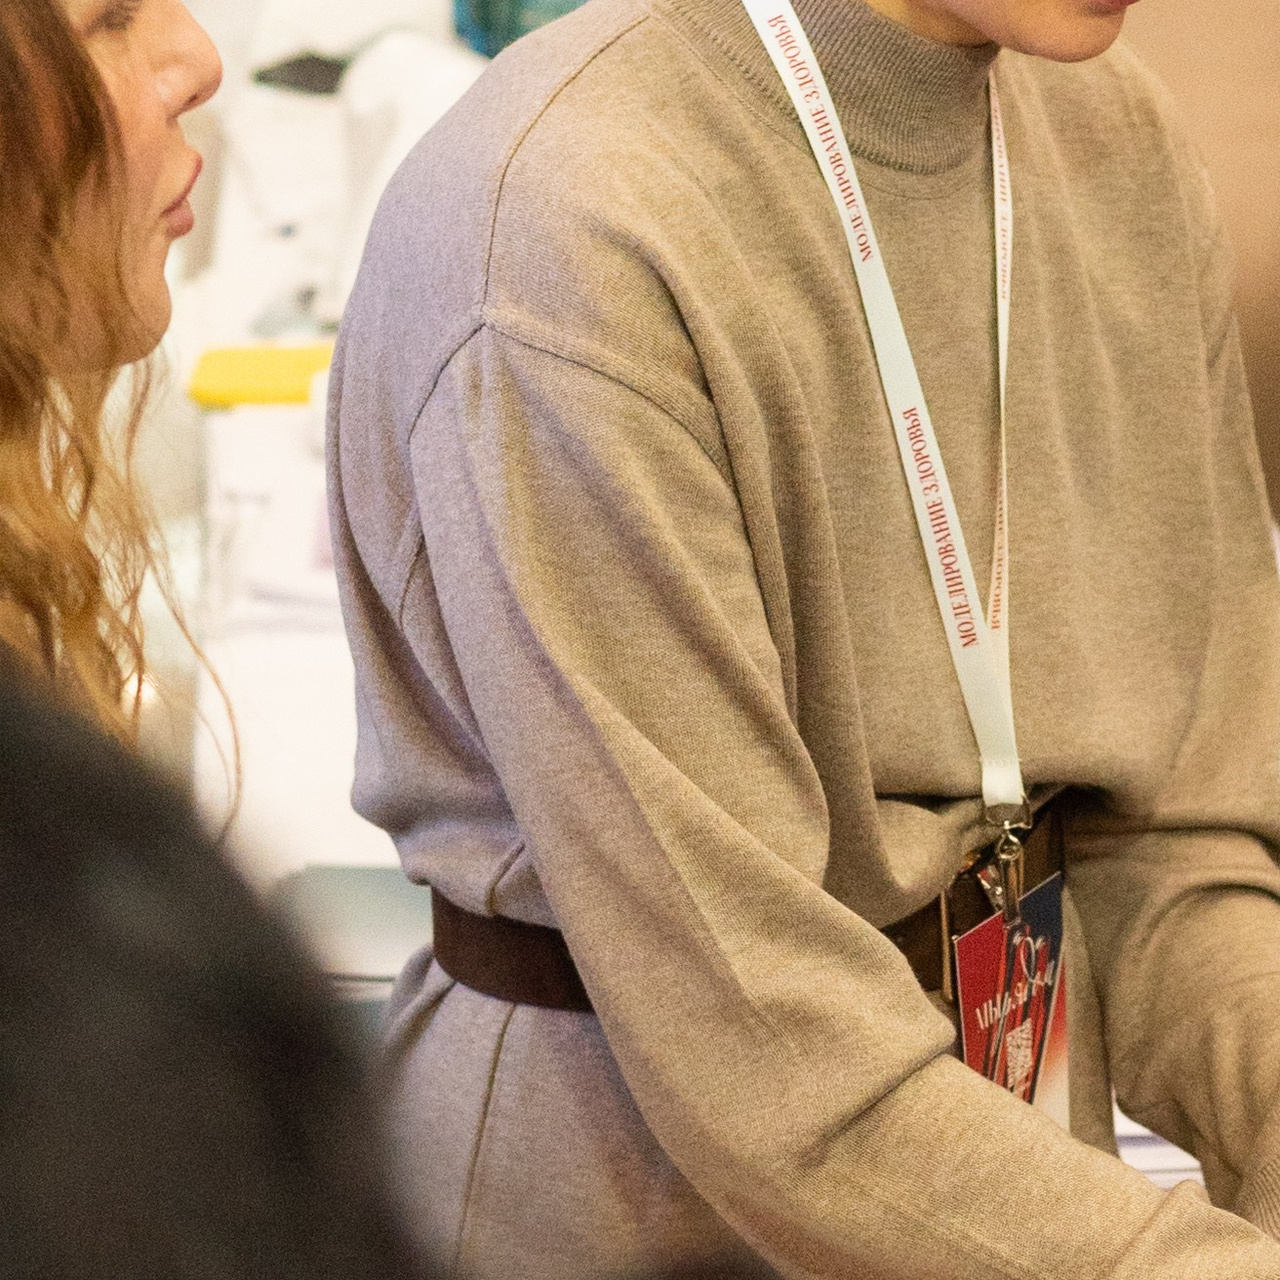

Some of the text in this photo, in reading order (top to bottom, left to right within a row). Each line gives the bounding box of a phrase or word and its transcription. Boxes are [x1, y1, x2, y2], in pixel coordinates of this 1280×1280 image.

[767, 14, 875, 263] МОДЕЛИРОВАНИЕ ЗДОРОВЬЯ
[902, 406, 979, 648] МОДЕЛИРОВАНИЕ ЗДОРОВЬЯ
